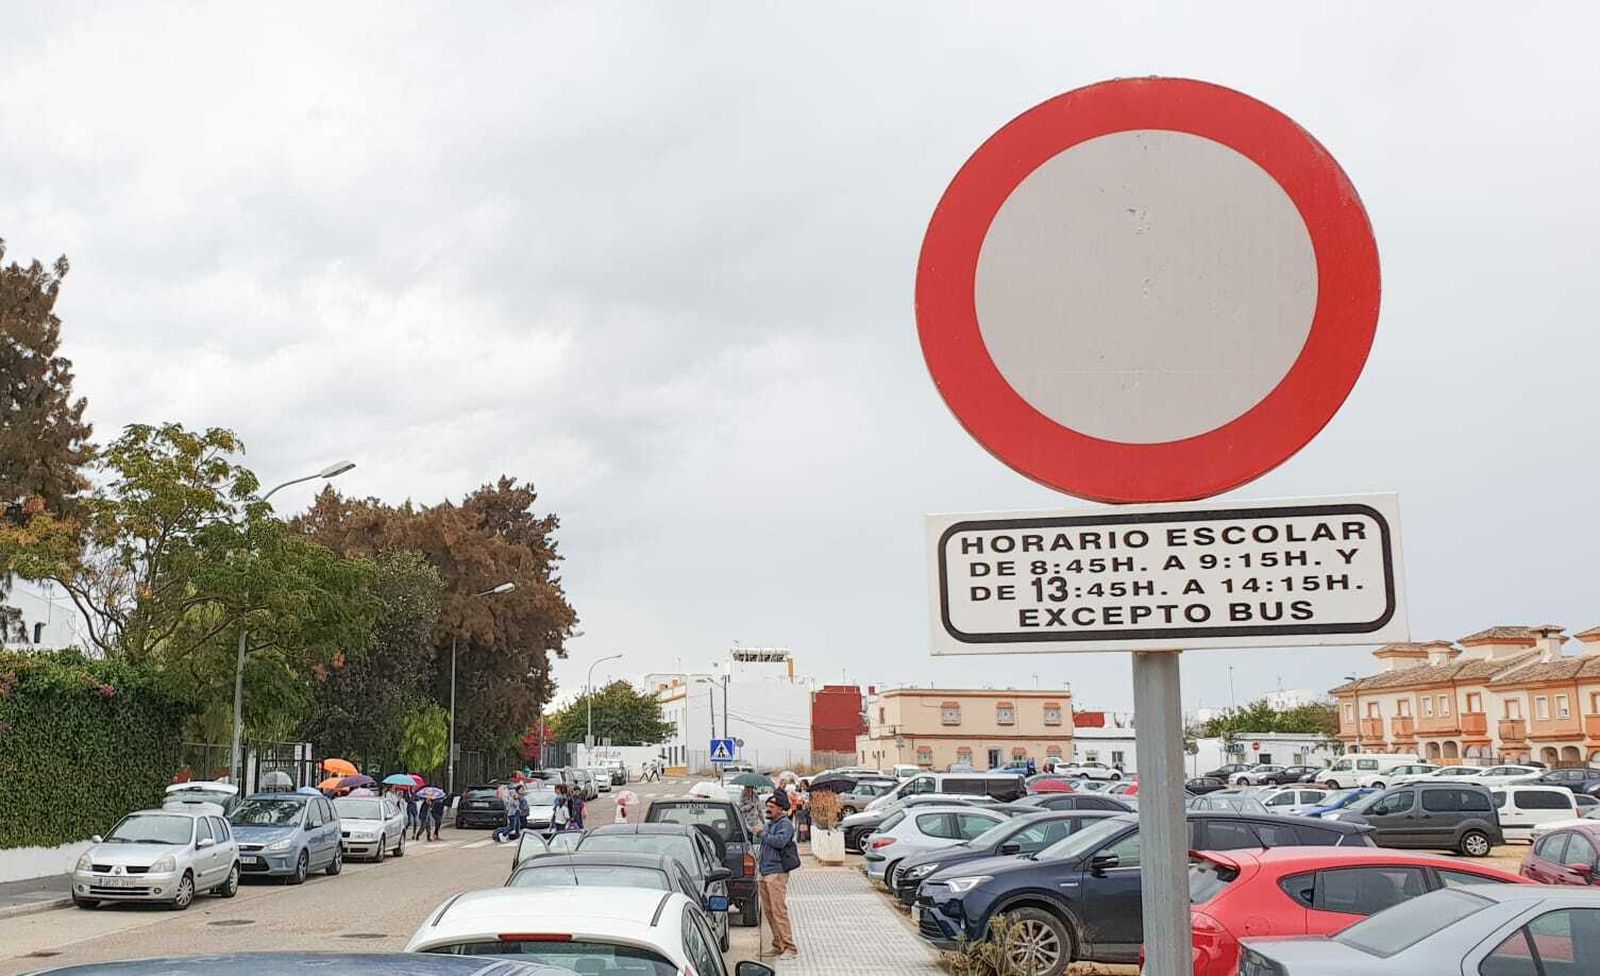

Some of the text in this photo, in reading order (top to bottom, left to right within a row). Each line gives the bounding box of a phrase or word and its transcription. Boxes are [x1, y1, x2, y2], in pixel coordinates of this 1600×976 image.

[961, 521, 1367, 555] HORARIO ESCOLAR
[969, 548, 1359, 578] DE 8:45H. A 9:15H. Y
[970, 573, 1364, 603] DE 13:45H. A 14:15H.
[1018, 600, 1314, 628] EXCEPTO BUS
